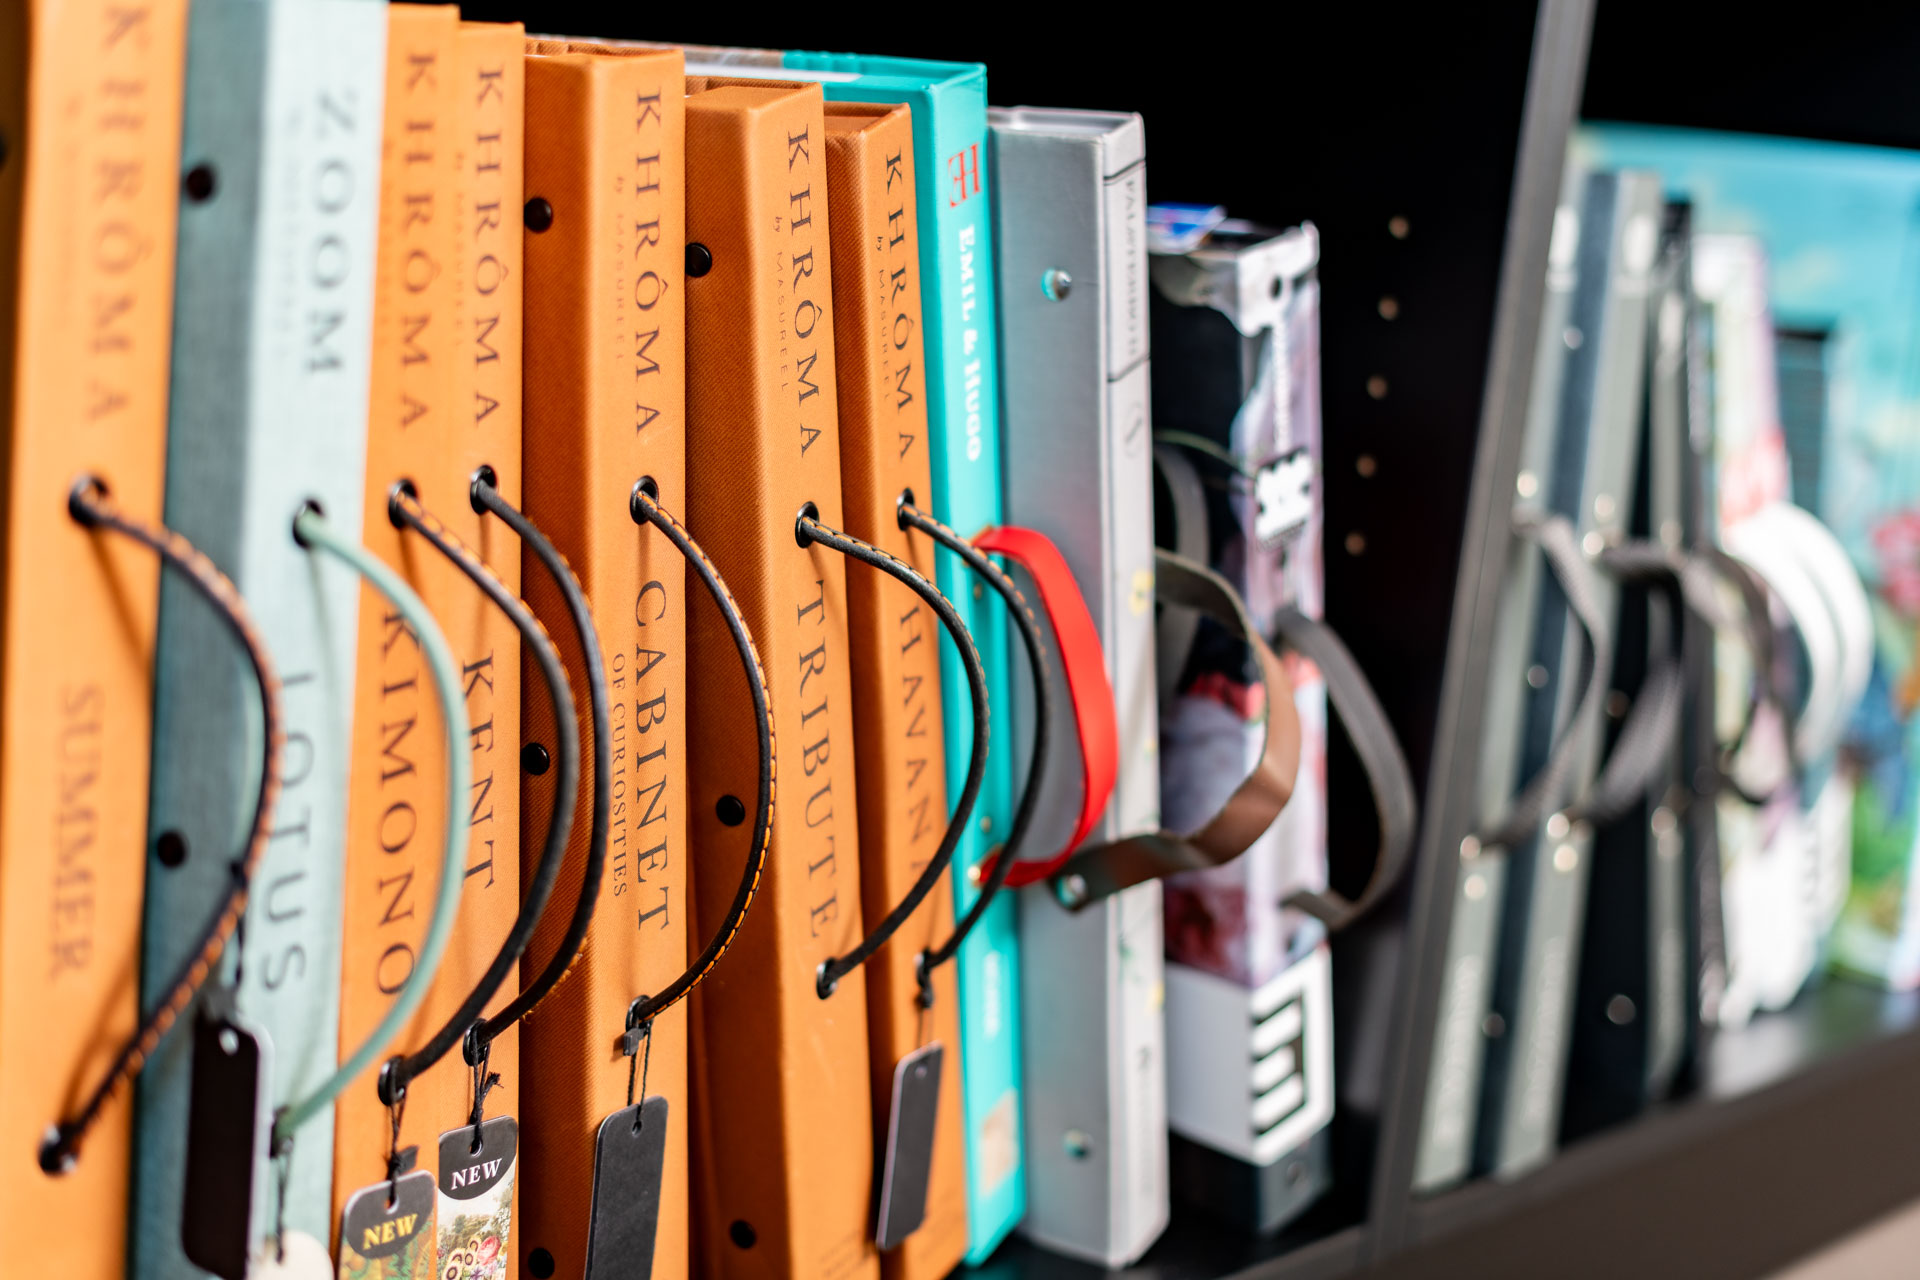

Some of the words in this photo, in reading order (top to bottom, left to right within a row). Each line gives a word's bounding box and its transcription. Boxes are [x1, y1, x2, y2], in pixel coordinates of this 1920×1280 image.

[89, 3, 152, 424] KHRÔMA
[306, 88, 357, 375] ZOOM
[401, 53, 441, 430] KHRÔMA
[475, 67, 509, 427] KHRÔMA
[636, 87, 669, 435] KHRÔMA
[773, 216, 782, 233] by
[775, 251, 788, 393] MASUREEL
[787, 123, 823, 458] KHRÔMA
[876, 236, 884, 252] by
[878, 269, 891, 401] MASUREEL
[885, 147, 915, 458] KHRÔMA
[959, 224, 975, 322] EMIL
[963, 329, 978, 356] &
[965, 358, 981, 462] HUGO
[377, 610, 420, 995] KIMONO
[612, 653, 626, 693] OF
[612, 702, 628, 897] CURIOSITIES
[635, 579, 670, 931] CABINET
[797, 579, 839, 938] TRIBUTE
[899, 605, 931, 873] HAVAN
[51, 684, 104, 984] SUMMER
[362, 1213, 418, 1250] NEW
[450, 1157, 502, 1190] NEW
